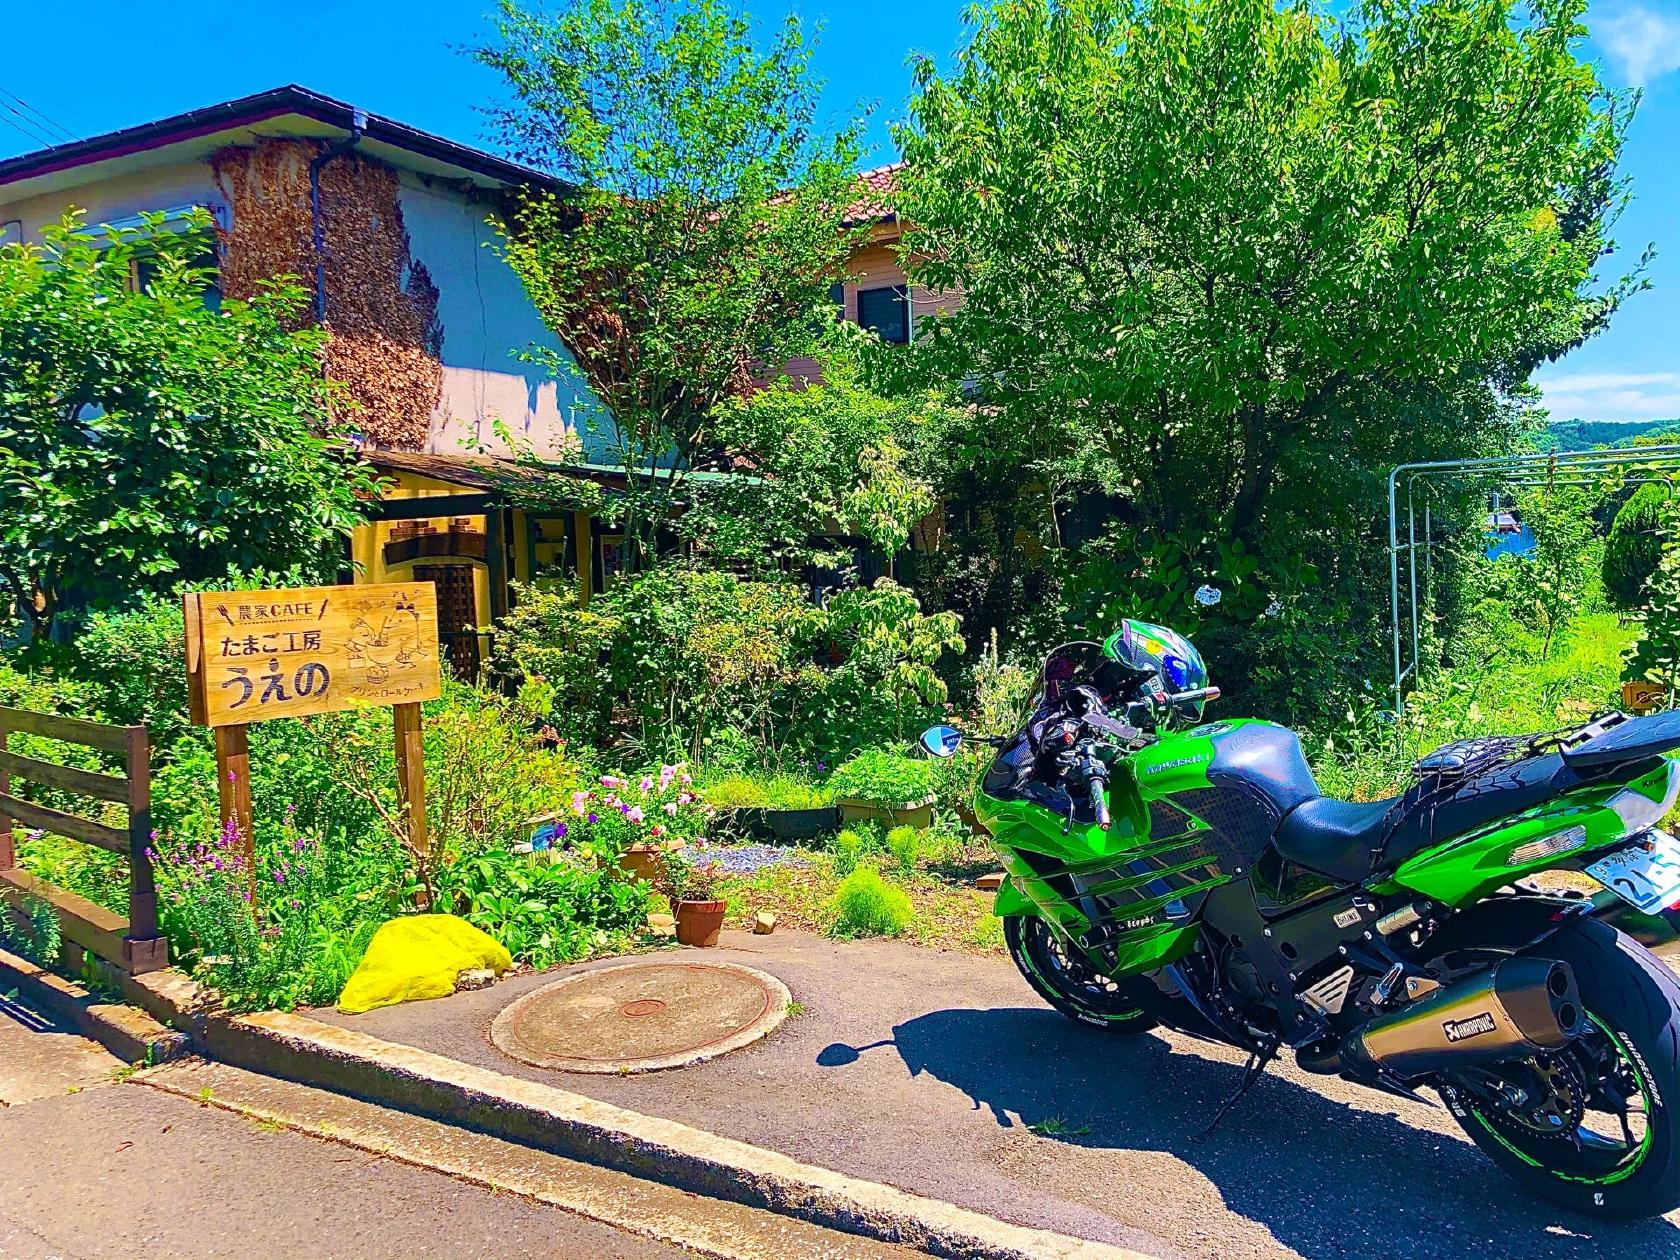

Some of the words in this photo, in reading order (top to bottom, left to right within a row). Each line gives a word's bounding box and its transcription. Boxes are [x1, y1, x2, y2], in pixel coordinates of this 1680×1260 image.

[221, 630, 321, 657] たまご工房
[221, 657, 330, 708] うえの
